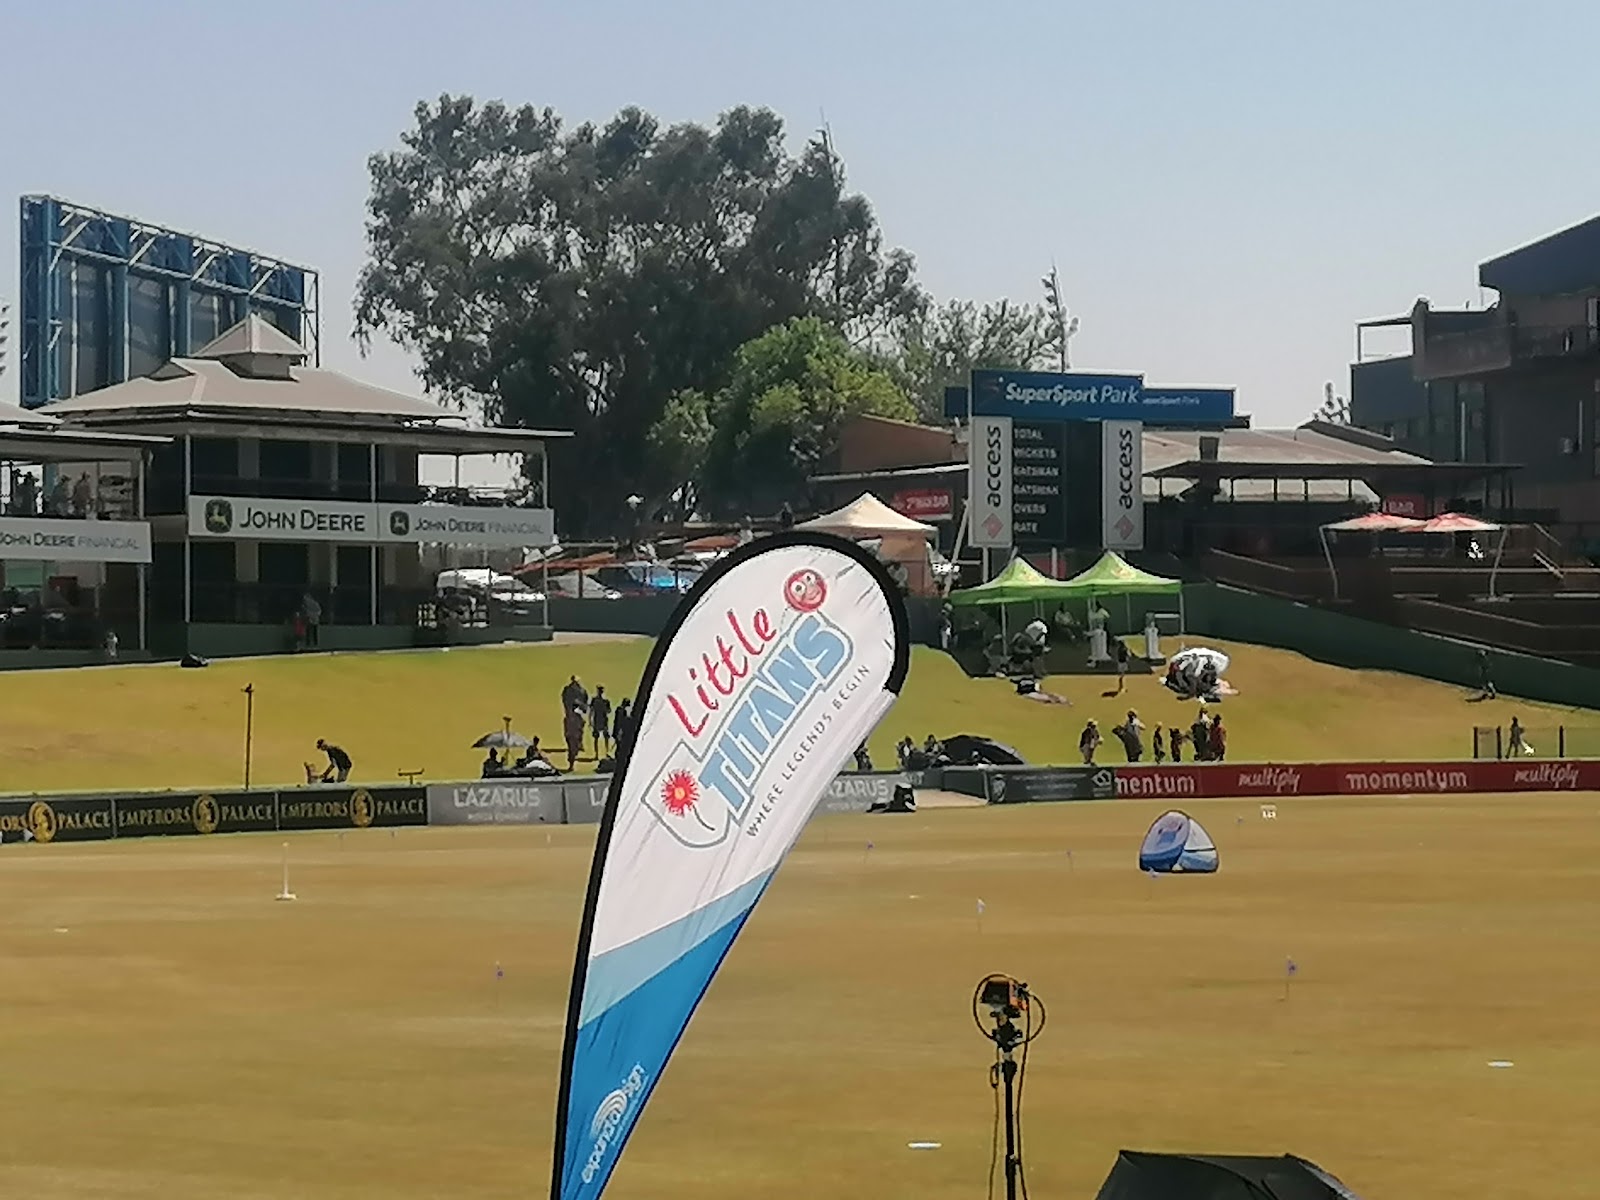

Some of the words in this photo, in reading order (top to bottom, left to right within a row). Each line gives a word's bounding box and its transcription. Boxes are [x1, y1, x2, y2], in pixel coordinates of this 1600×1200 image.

[1005, 383, 1098, 406] SuperSport
[1100, 386, 1139, 404] Park
[1014, 428, 1043, 440] TOTAL
[1014, 448, 1057, 458] WICKETS
[987, 425, 1001, 507] access
[1119, 428, 1133, 509] access
[240, 507, 296, 529] JOHN
[300, 509, 366, 532] DEERE
[1014, 504, 1046, 514] OVERS
[415, 517, 446, 532] JOHN
[450, 518, 486, 533] DEERE
[488, 520, 544, 535] FINANCIAL
[1014, 522, 1038, 533] RATE
[0, 532, 31, 546] OHN
[34, 532, 76, 548] DEERE
[667, 608, 777, 738] Little
[698, 614, 847, 811] TITANS
[747, 783, 784, 838] WHERE
[781, 712, 833, 781] LEGENDS
[832, 665, 871, 711] BEGIN
[1238, 768, 1300, 794] multiply
[1346, 768, 1467, 791] momentum
[1514, 763, 1580, 788] multiply
[280, 801, 348, 819] EMPERORS
[377, 799, 424, 815] PALACE
[453, 787, 541, 808] LAZARUS
[58, 810, 111, 829] PALACE
[118, 806, 191, 828] EMPERORS
[221, 804, 273, 822] PALACE
